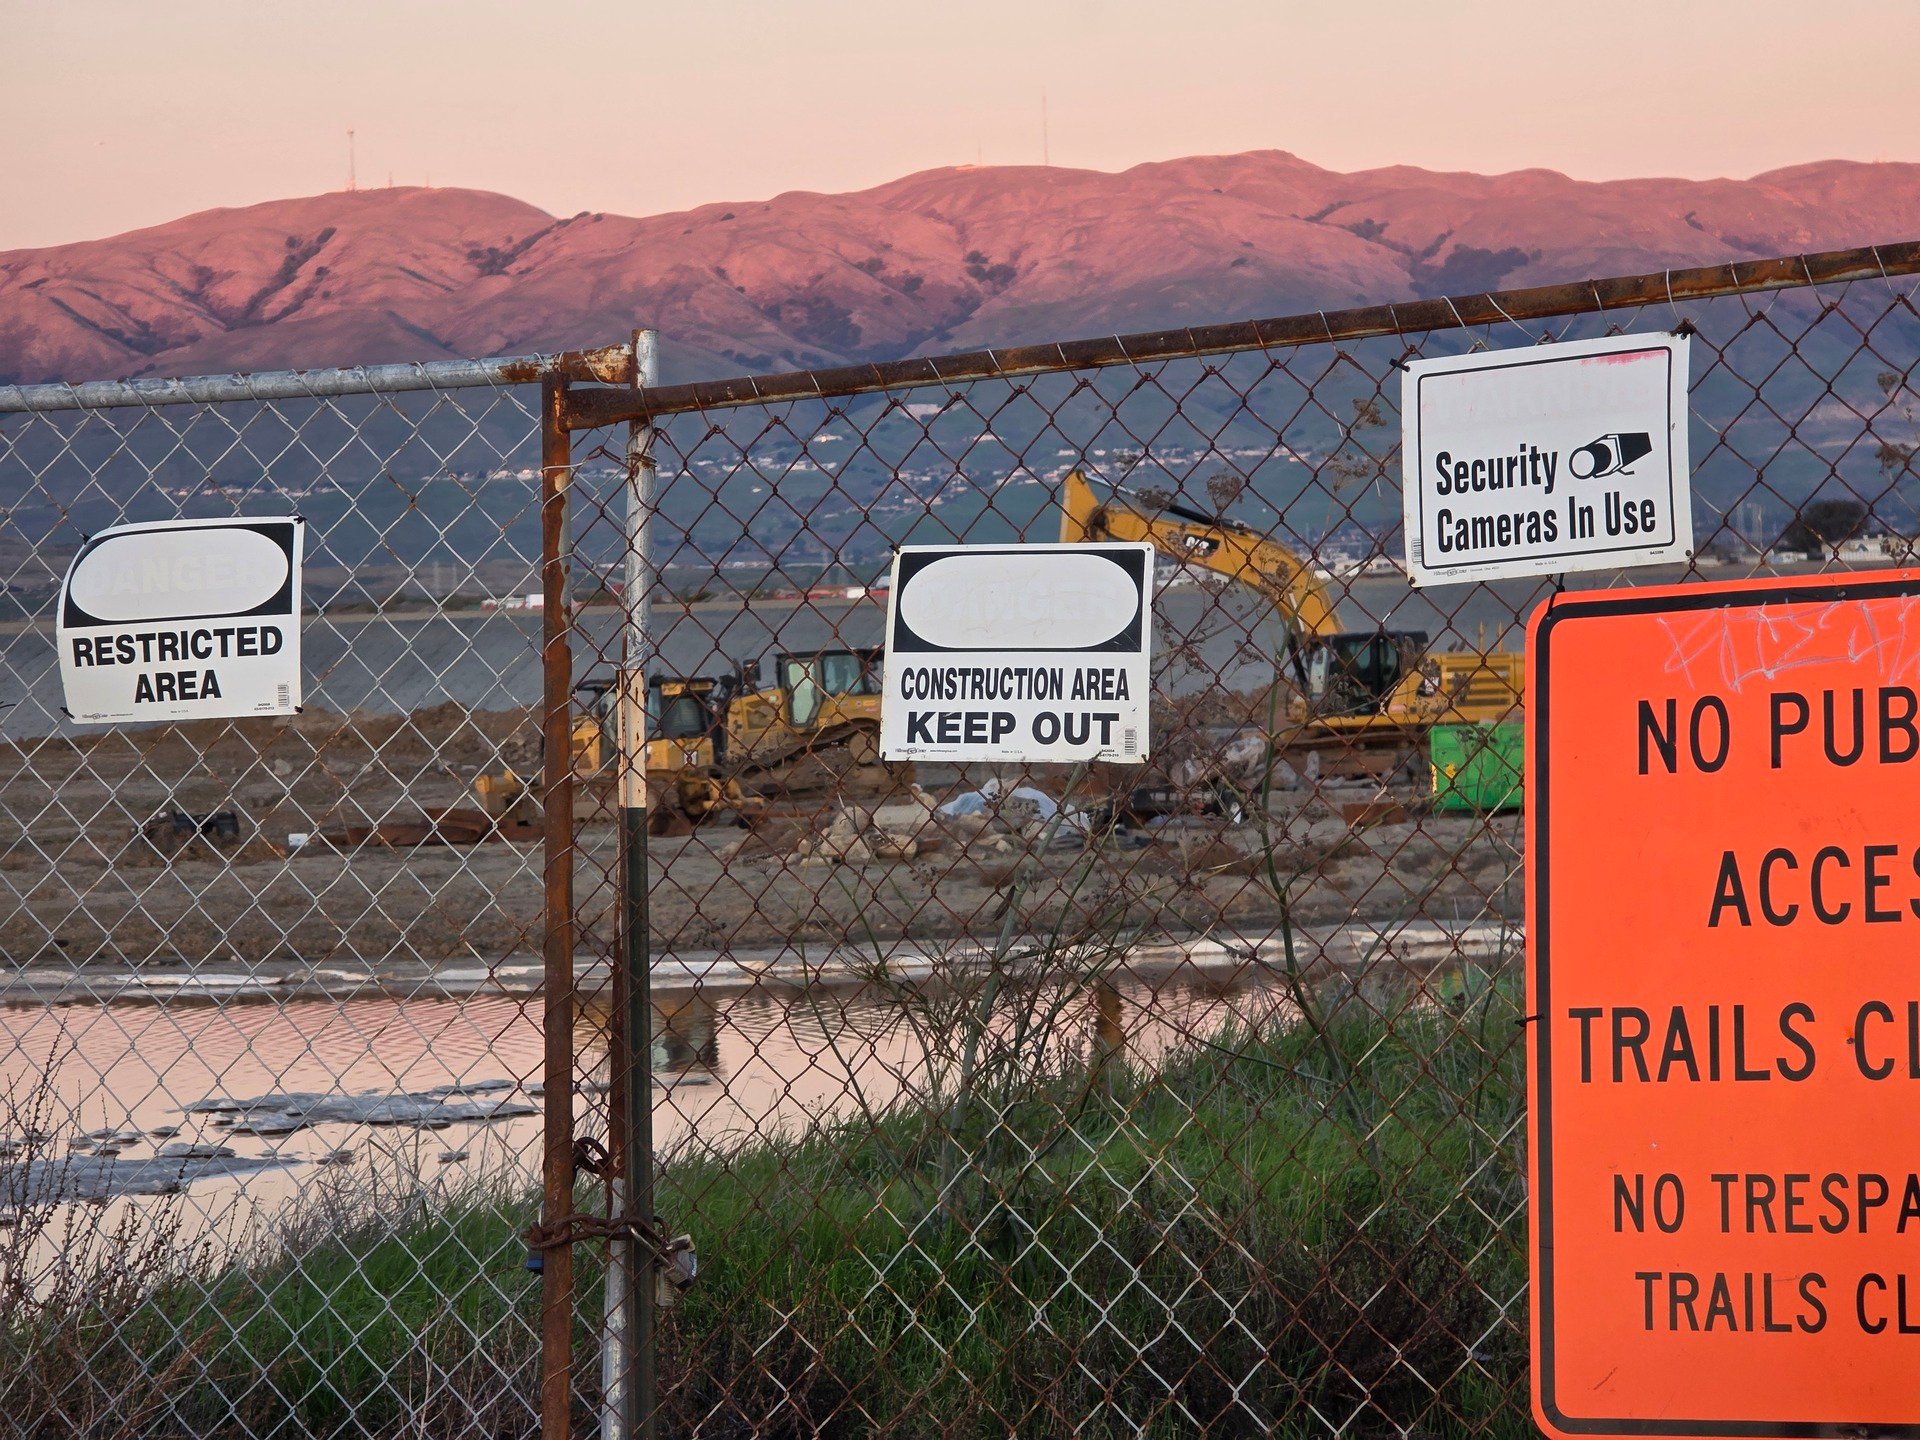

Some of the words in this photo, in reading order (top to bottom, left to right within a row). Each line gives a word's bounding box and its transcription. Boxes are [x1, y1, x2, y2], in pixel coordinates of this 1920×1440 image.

[1436, 443, 1558, 496] Security
[1437, 508, 1558, 553] Cameras
[1568, 496, 1595, 540] In
[1604, 491, 1656, 537] Use
[72, 625, 283, 668] RESTRICTED
[135, 669, 222, 704] AREA
[901, 667, 1064, 701] CONSTRUCTION
[1070, 668, 1130, 701] AREA
[906, 711, 1017, 744] KEEP
[1031, 711, 1120, 746] OUT
[1638, 695, 1730, 775] NO
[1770, 686, 1920, 769] PUB
[1708, 845, 1920, 928] ACCE
[1568, 1002, 1816, 1083] TRAILS
[1614, 1173, 1685, 1233] NO
[1711, 1173, 1920, 1234] TRESPA
[1635, 1271, 1827, 1334] TRAILS
[1856, 1272, 1920, 1335] CL
